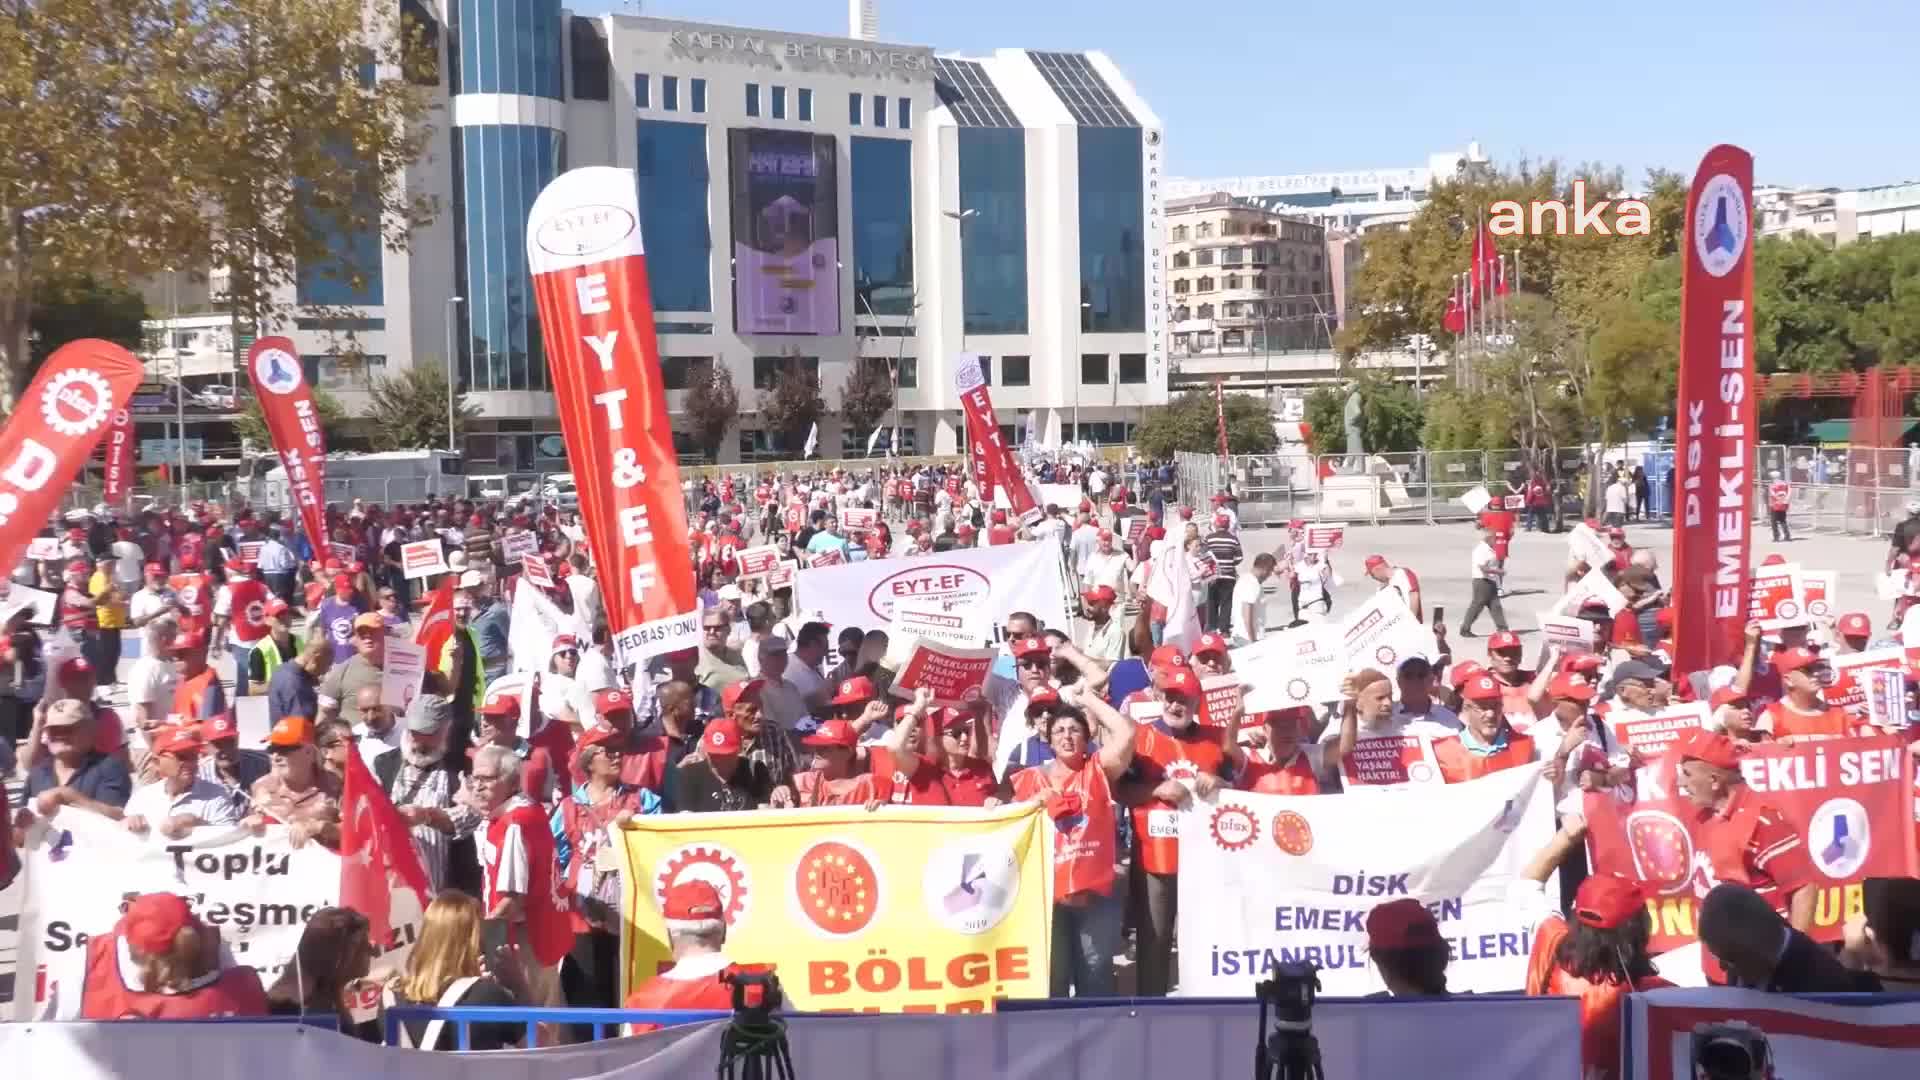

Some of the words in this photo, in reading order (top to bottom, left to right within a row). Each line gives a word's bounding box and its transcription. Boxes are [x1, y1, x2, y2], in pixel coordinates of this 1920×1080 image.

[892, 573, 966, 596] EYT-EF
[1838, 747, 1901, 787] SEN
[166, 844, 290, 880] Toplu
[1332, 870, 1410, 896] DİSK
[1275, 905, 1365, 933] EMEK
[807, 946, 1031, 995] BÖLGE
